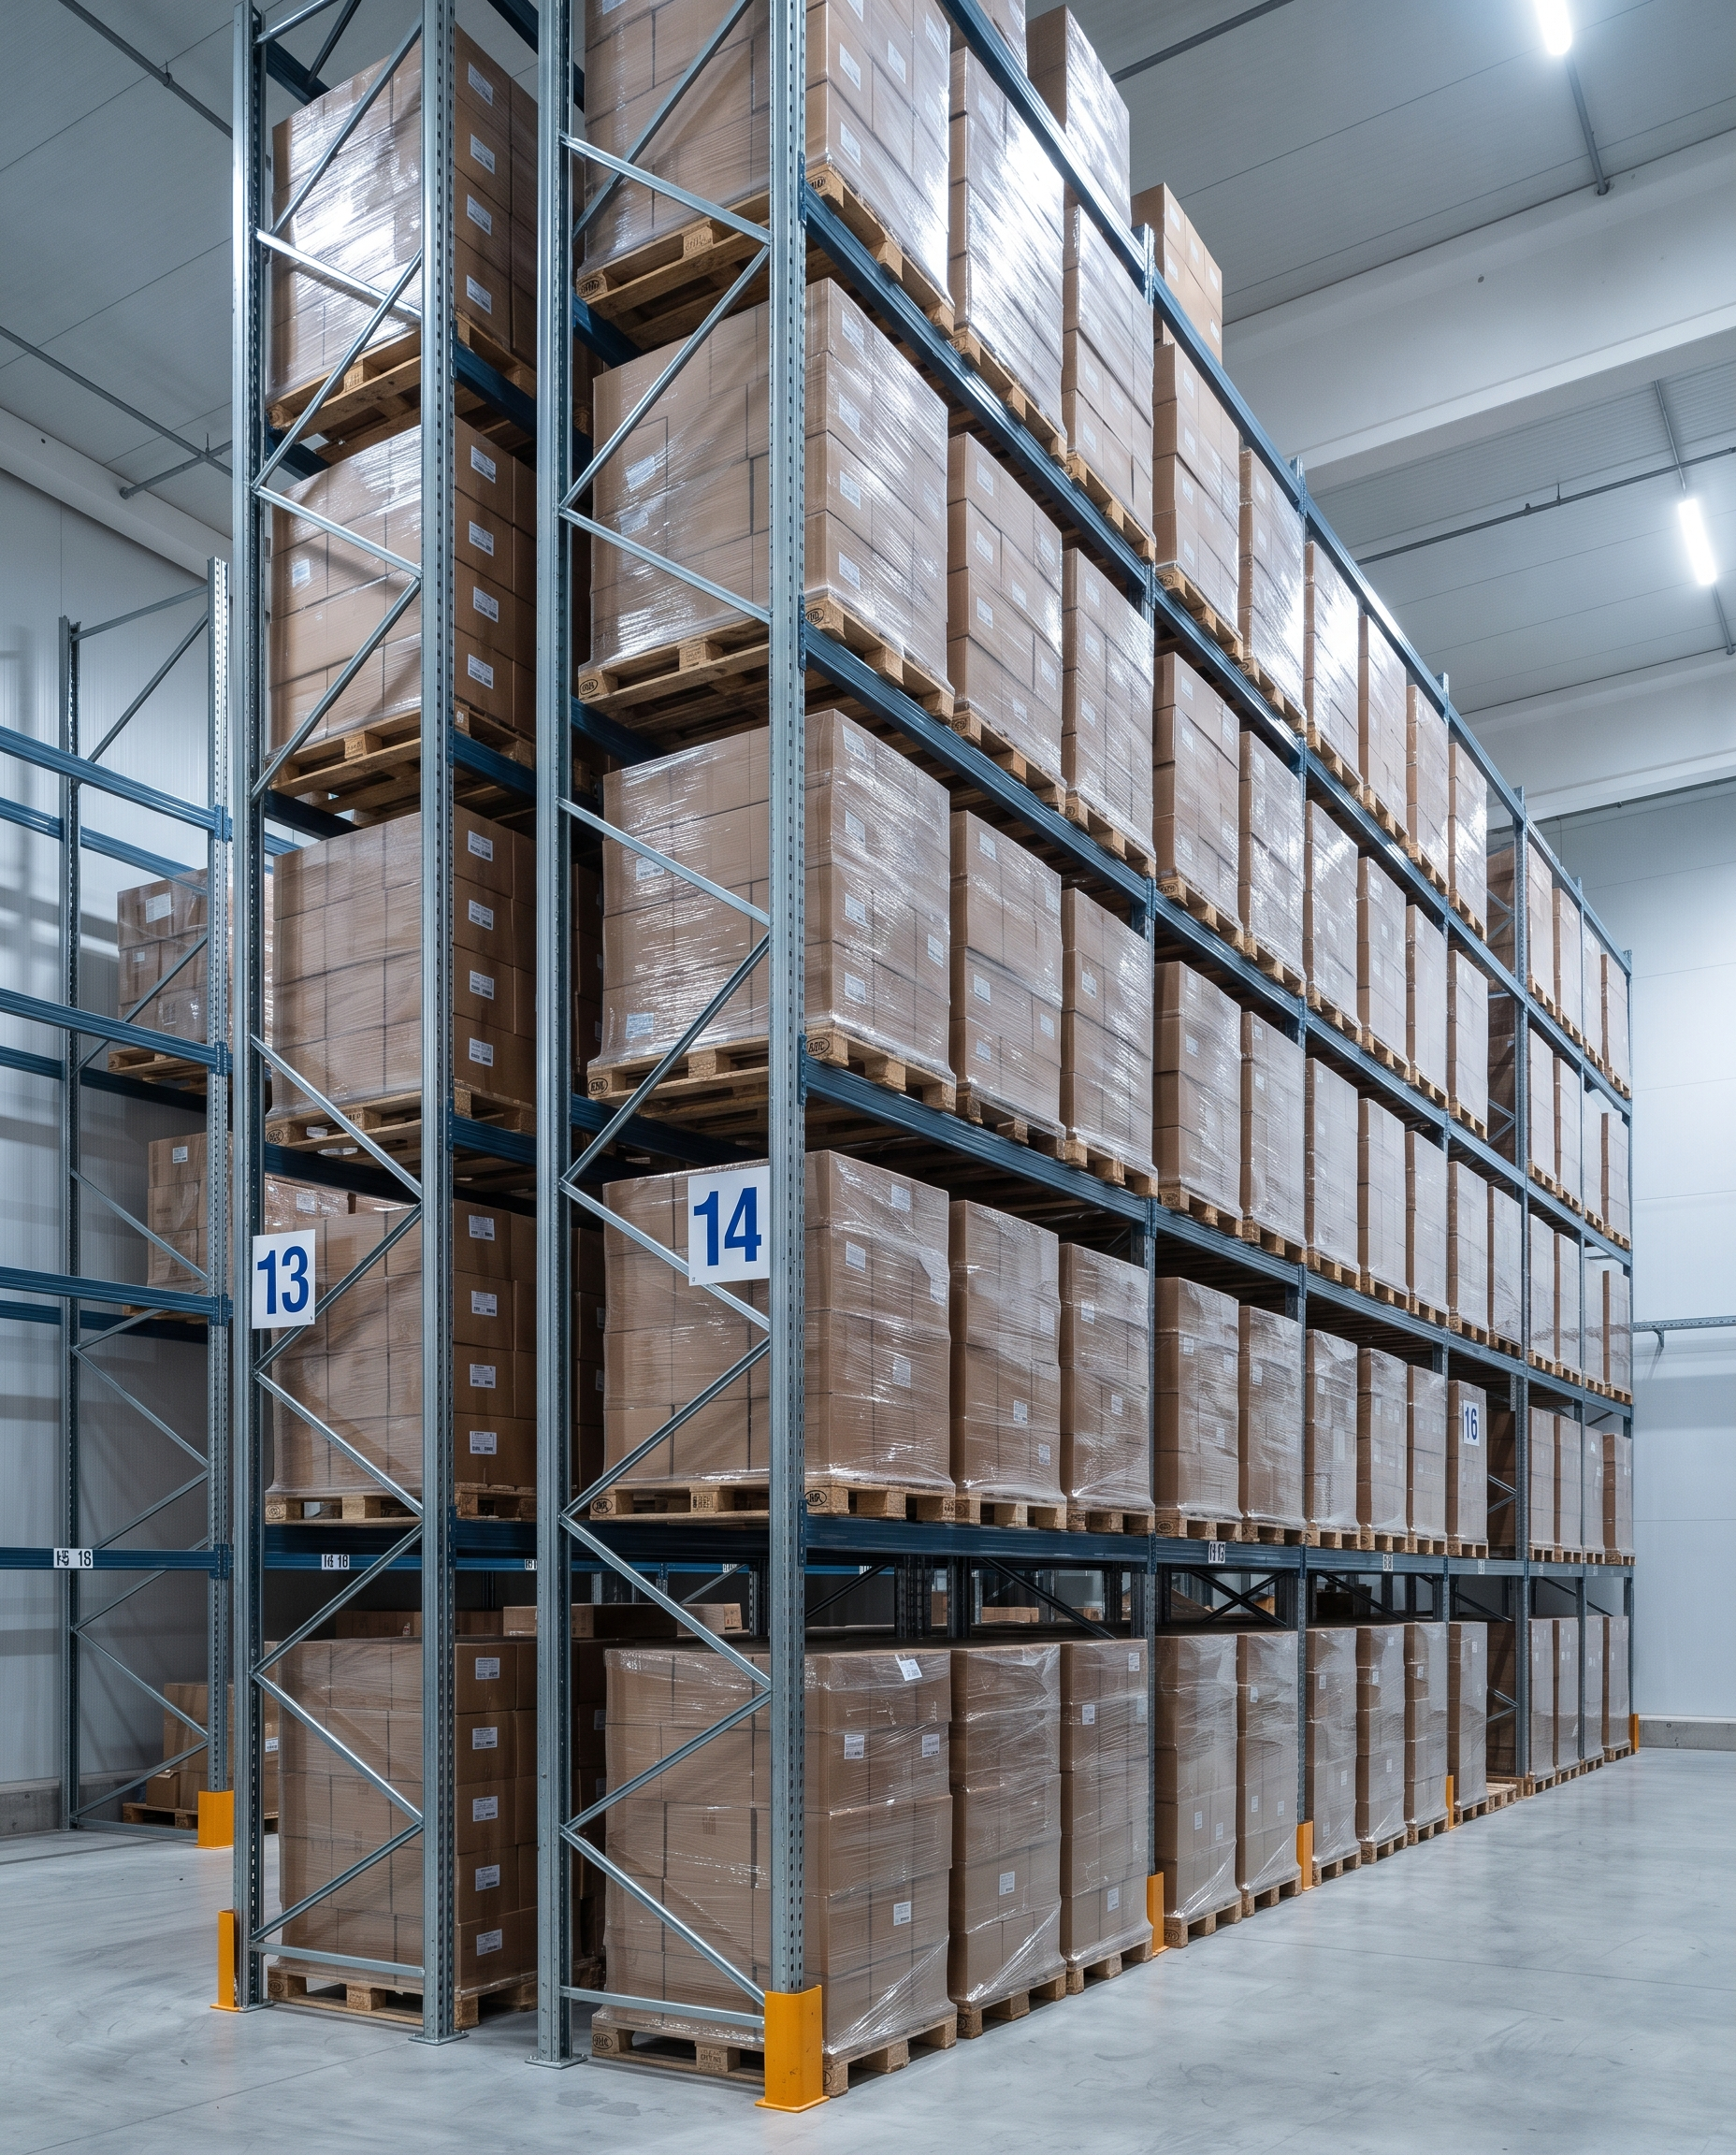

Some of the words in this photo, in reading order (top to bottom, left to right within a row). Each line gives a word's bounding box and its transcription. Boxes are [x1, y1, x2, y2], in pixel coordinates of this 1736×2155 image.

[694, 1187, 761, 1266] 14
[257, 1246, 309, 1315] 13
[1465, 1407, 1478, 1440] 16
[78, 1550, 92, 1567] 18
